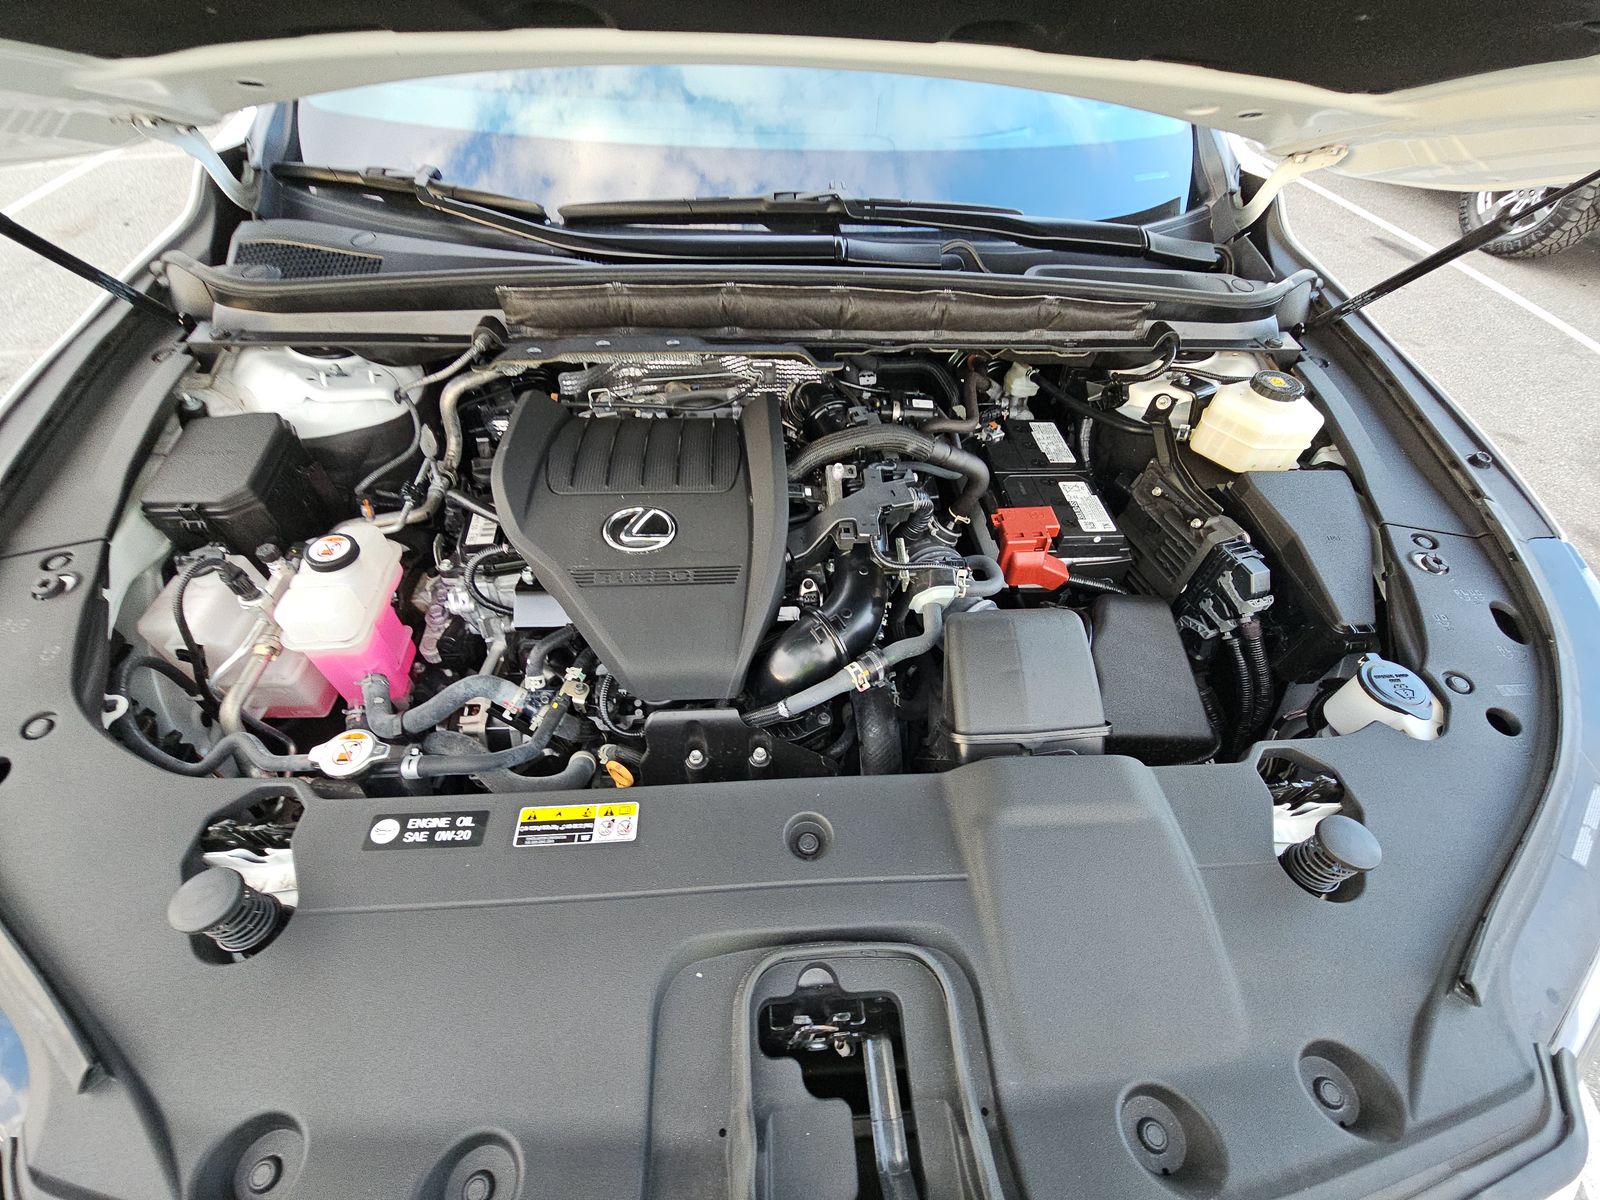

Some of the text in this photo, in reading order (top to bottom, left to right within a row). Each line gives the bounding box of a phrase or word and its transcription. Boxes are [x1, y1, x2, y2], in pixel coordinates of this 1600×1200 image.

[407, 816, 476, 829] ENGINE OIL
[402, 830, 472, 843] SAE 0W-20
